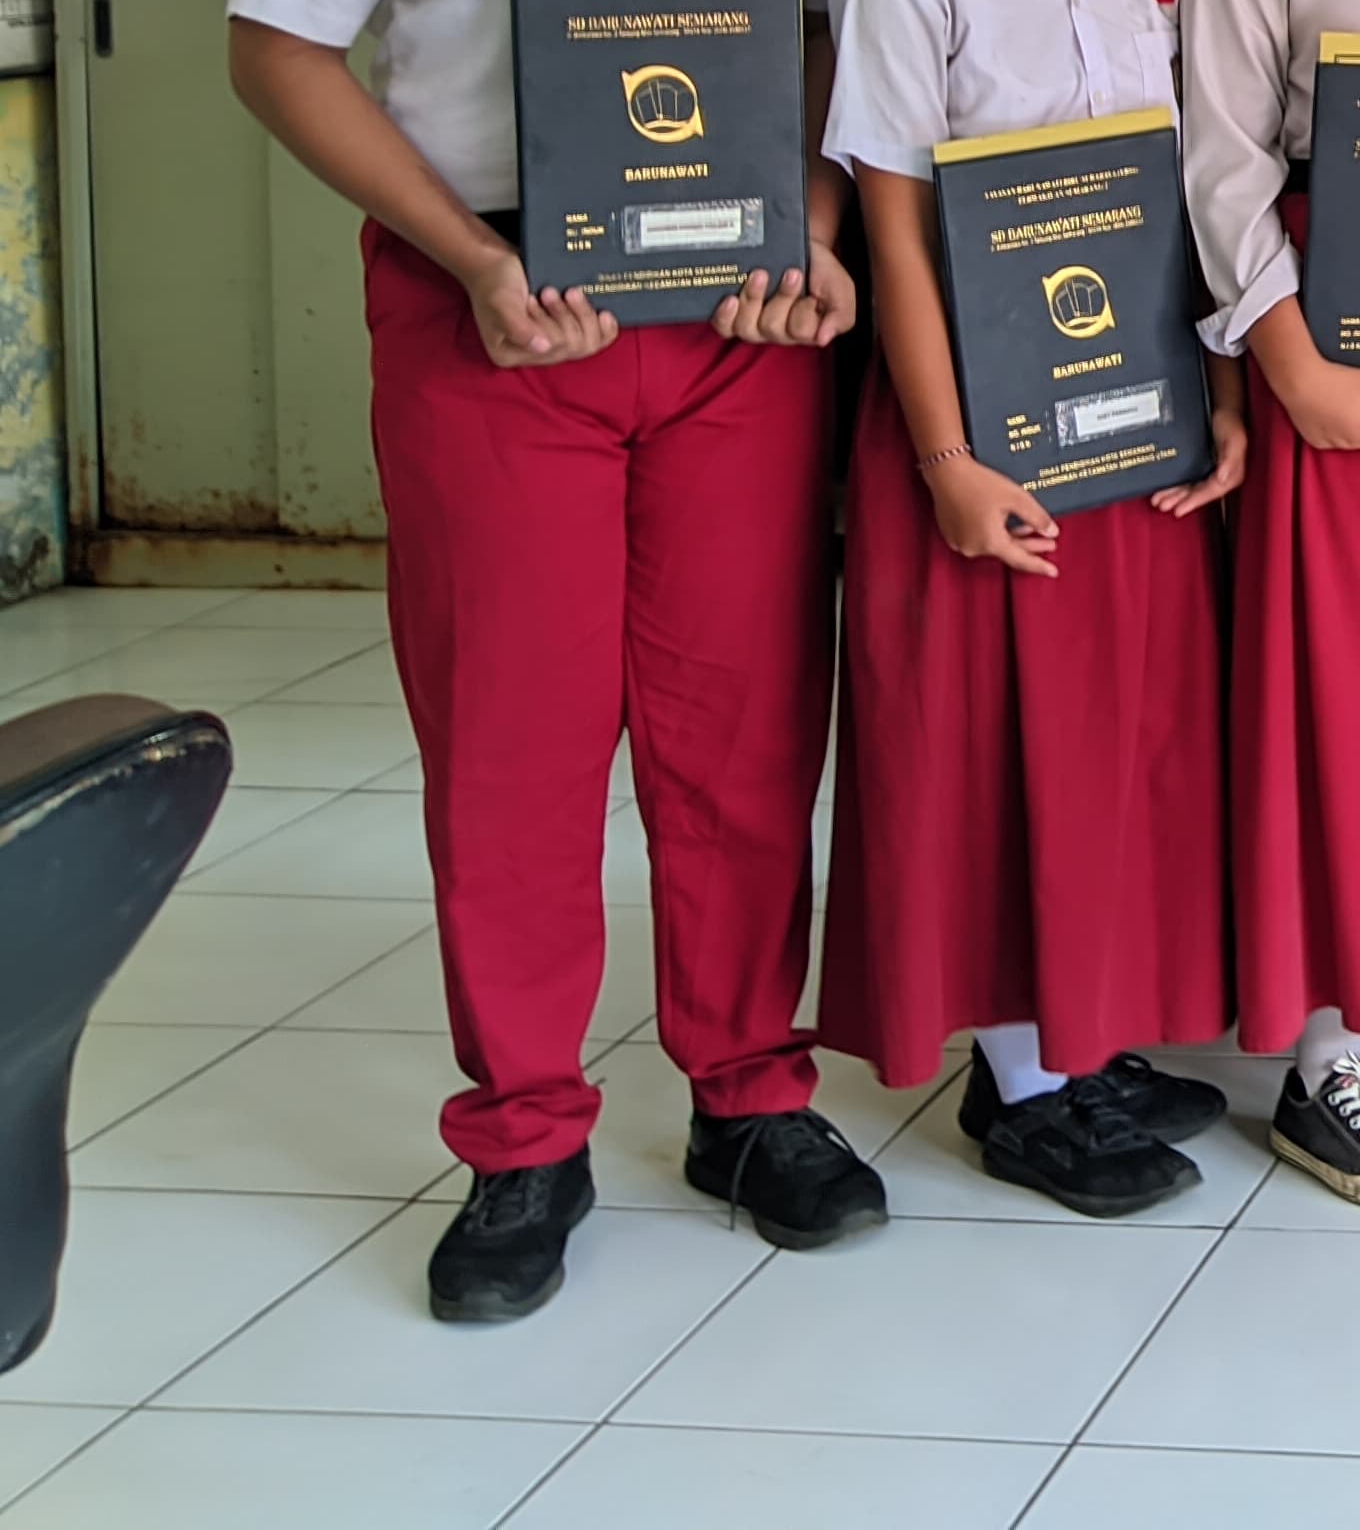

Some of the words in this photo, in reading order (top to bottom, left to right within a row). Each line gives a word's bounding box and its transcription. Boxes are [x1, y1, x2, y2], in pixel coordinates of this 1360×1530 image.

[589, 13, 674, 30] BARUNAWATI
[678, 11, 749, 28] SEMARANG
[625, 163, 709, 182] BARUNAWATI
[1008, 216, 1079, 240] BARUNAWATI
[1053, 352, 1122, 379] BARUNAWATI
